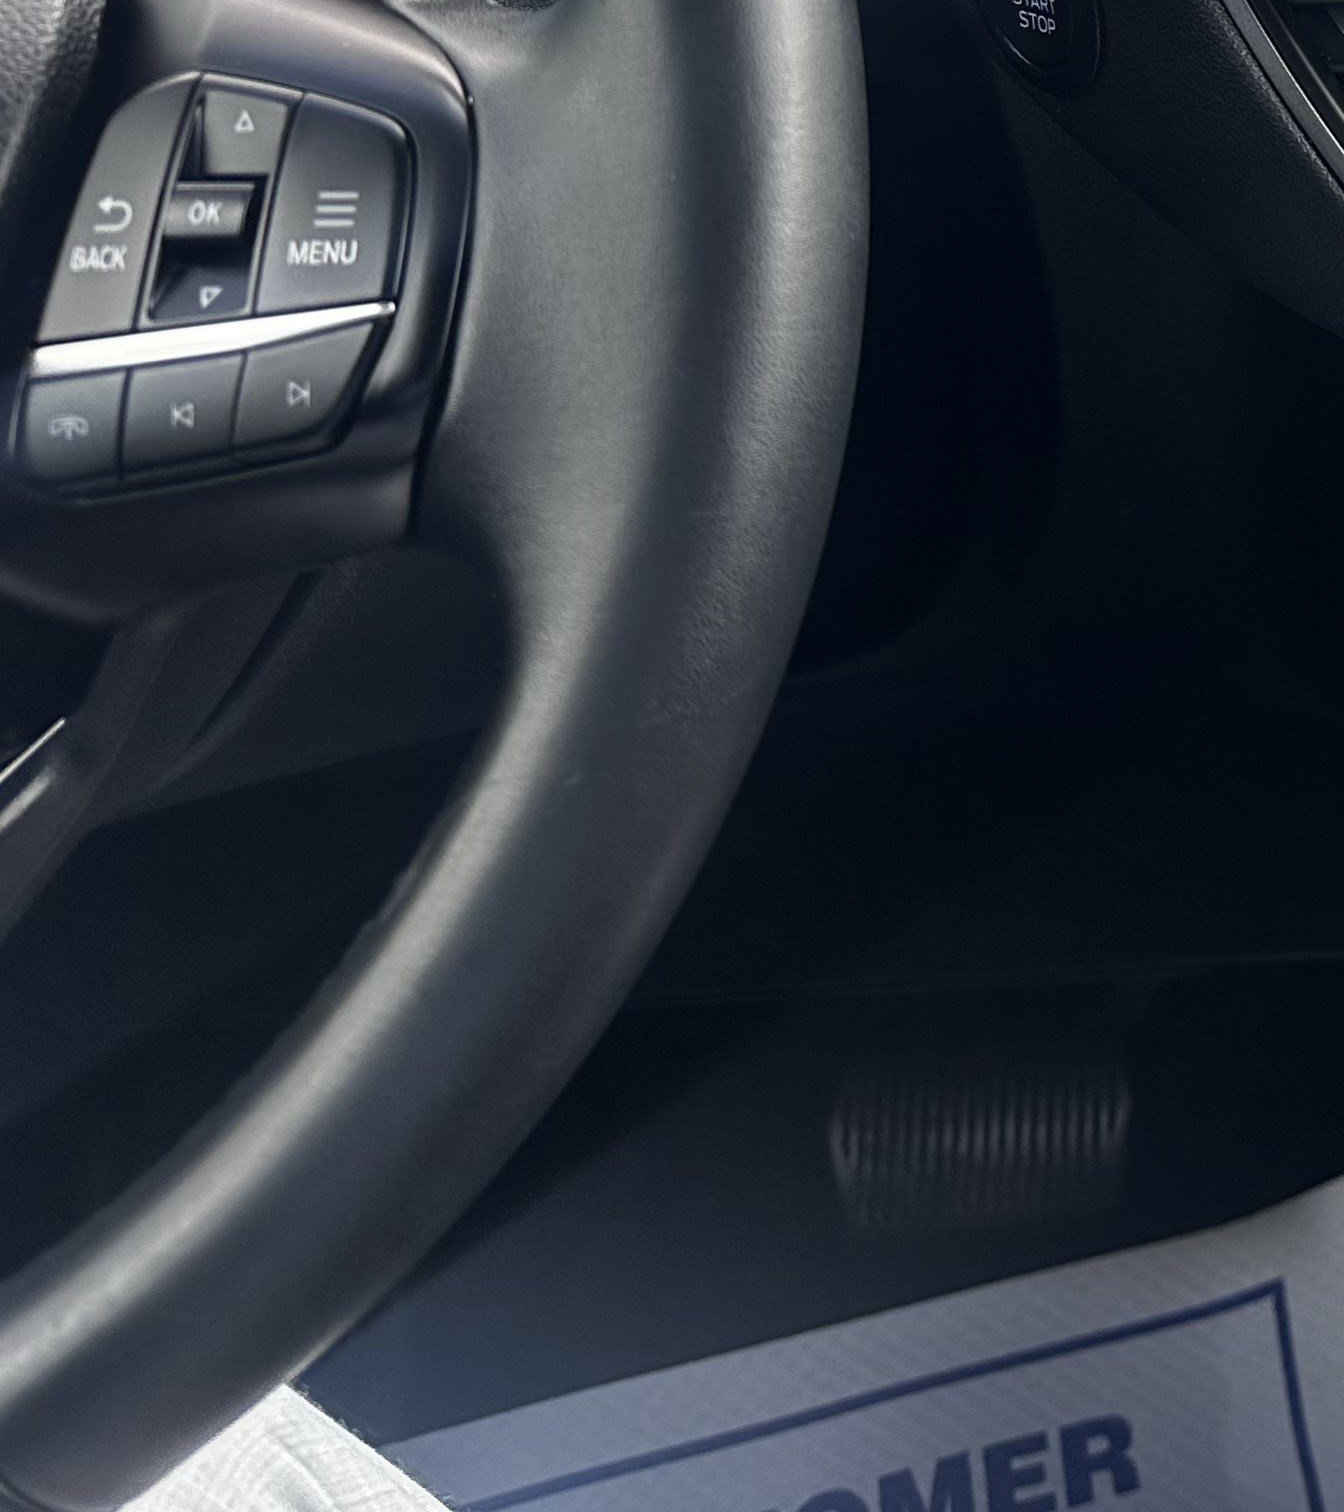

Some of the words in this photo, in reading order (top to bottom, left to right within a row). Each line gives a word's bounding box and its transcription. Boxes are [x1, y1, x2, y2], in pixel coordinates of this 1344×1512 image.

[1018, 9, 1056, 34] STOP
[187, 198, 221, 226] OK
[69, 243, 128, 273] BACK
[286, 239, 359, 266] MENU
